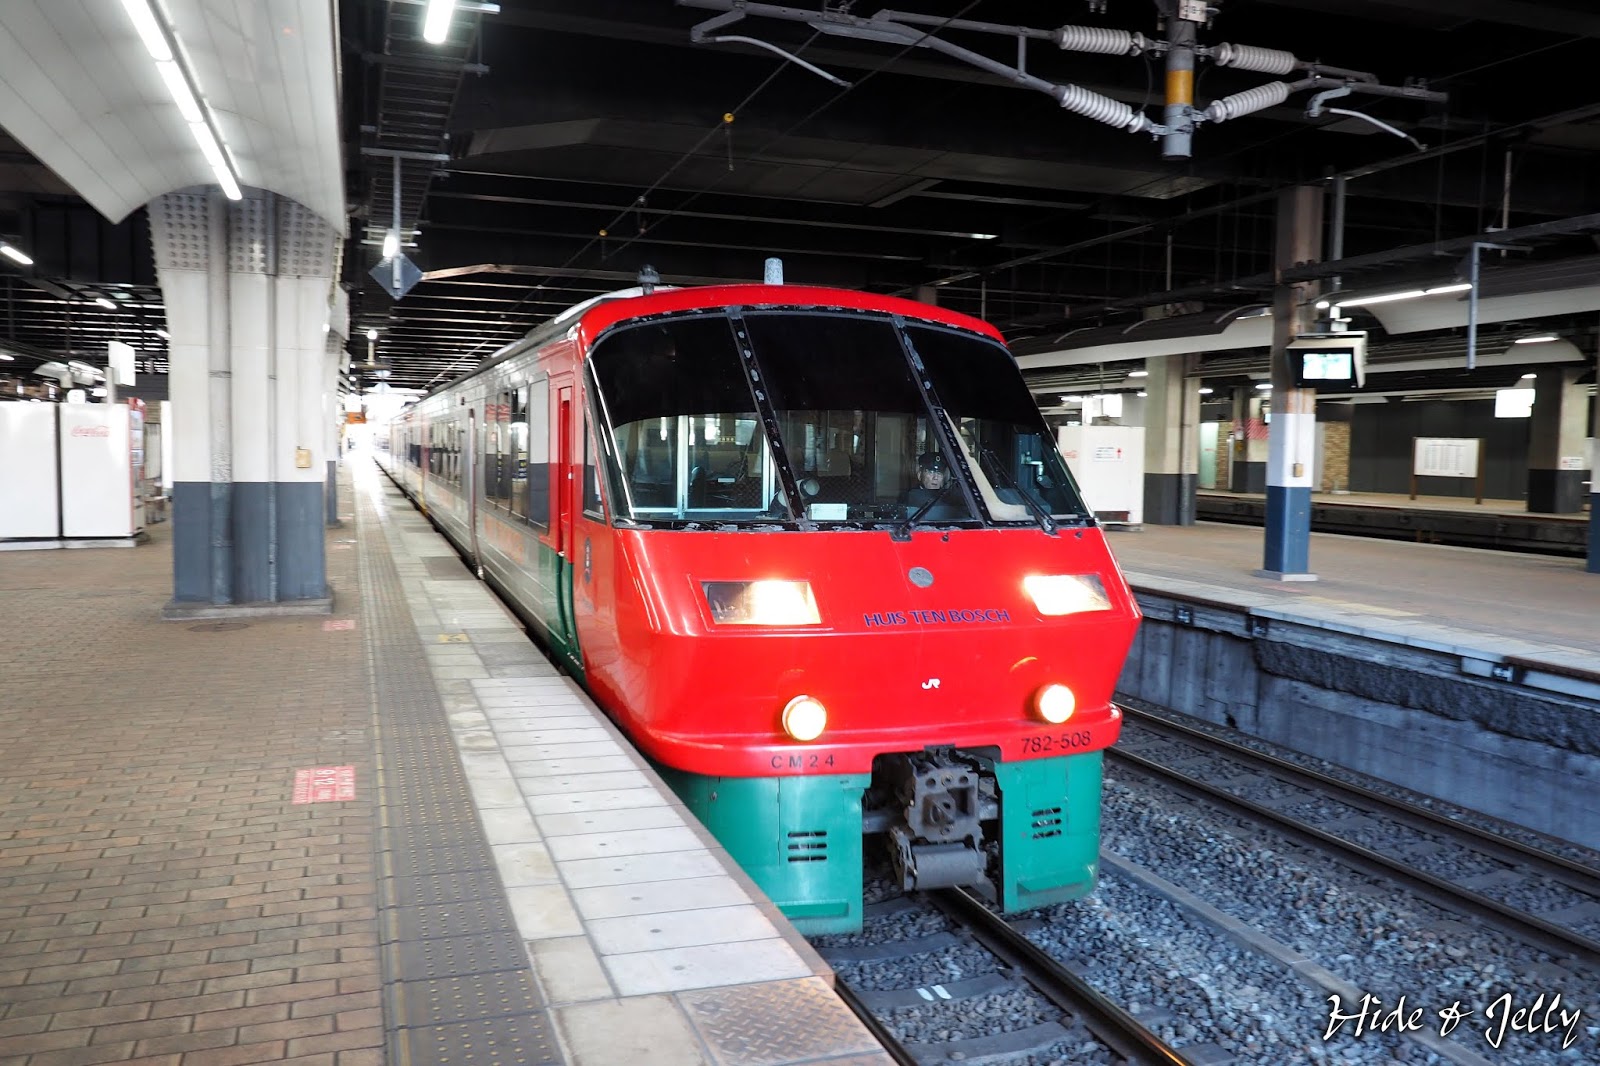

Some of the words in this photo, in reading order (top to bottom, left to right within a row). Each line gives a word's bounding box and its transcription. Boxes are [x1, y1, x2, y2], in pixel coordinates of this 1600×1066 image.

[863, 611, 907, 627] HUIS
[909, 609, 947, 624] TEN
[948, 608, 1011, 623] BOSCH
[921, 678, 941, 690] JR
[1021, 730, 1091, 754] 782-508
